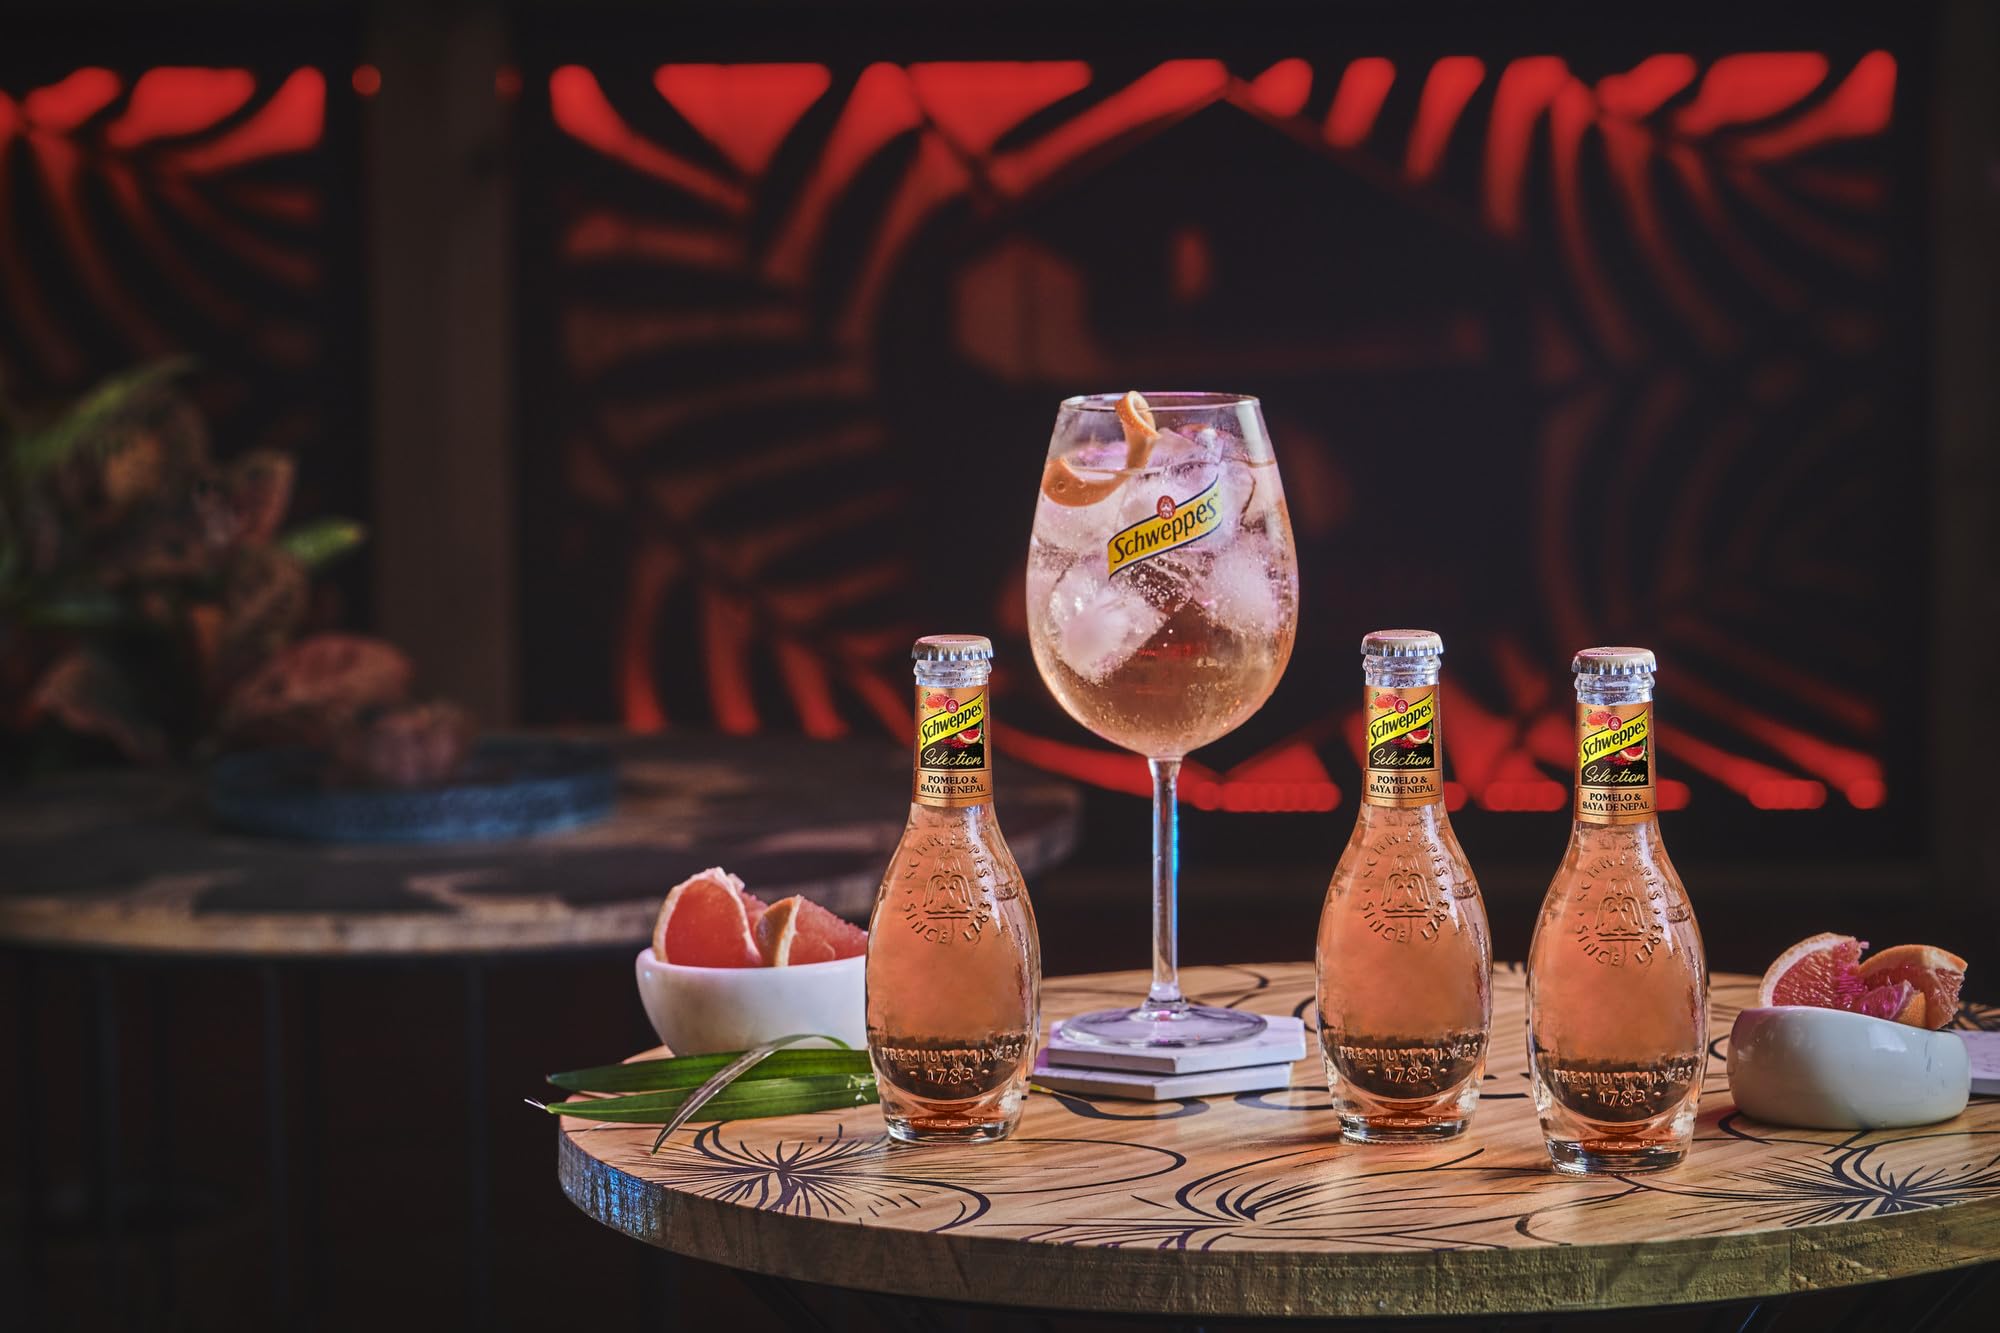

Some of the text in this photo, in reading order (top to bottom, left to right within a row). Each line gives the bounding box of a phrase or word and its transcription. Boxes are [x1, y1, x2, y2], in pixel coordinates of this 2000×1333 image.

[1113, 497, 1217, 564] Schweppes
[922, 701, 982, 746] Schweppes
[1371, 701, 1432, 746] Schweppes
[1583, 719, 1646, 763] Schweppes
[924, 748, 982, 766] Selection
[1372, 748, 1432, 766] Selection
[928, 775, 978, 785] POMELO &
[1377, 775, 1428, 785] POMELO &
[1585, 765, 1647, 783] Selection
[942, 785, 956, 794] DE
[957, 784, 985, 794] NEPAL
[1392, 785, 1405, 794] DE
[1407, 784, 1435, 794] NEPAL
[1590, 792, 1641, 802] POMELO &
[1605, 802, 1619, 812] DE
[1620, 801, 1649, 811] NEPAL
[881, 1046, 955, 1063] PREMIUM
[1339, 1045, 1412, 1061] PREMIUM
[927, 1067, 974, 1085] 1783
[1385, 1066, 1432, 1084] 1783
[1553, 1069, 1627, 1085] PREMIUM
[1600, 1089, 1646, 1107] 1783
